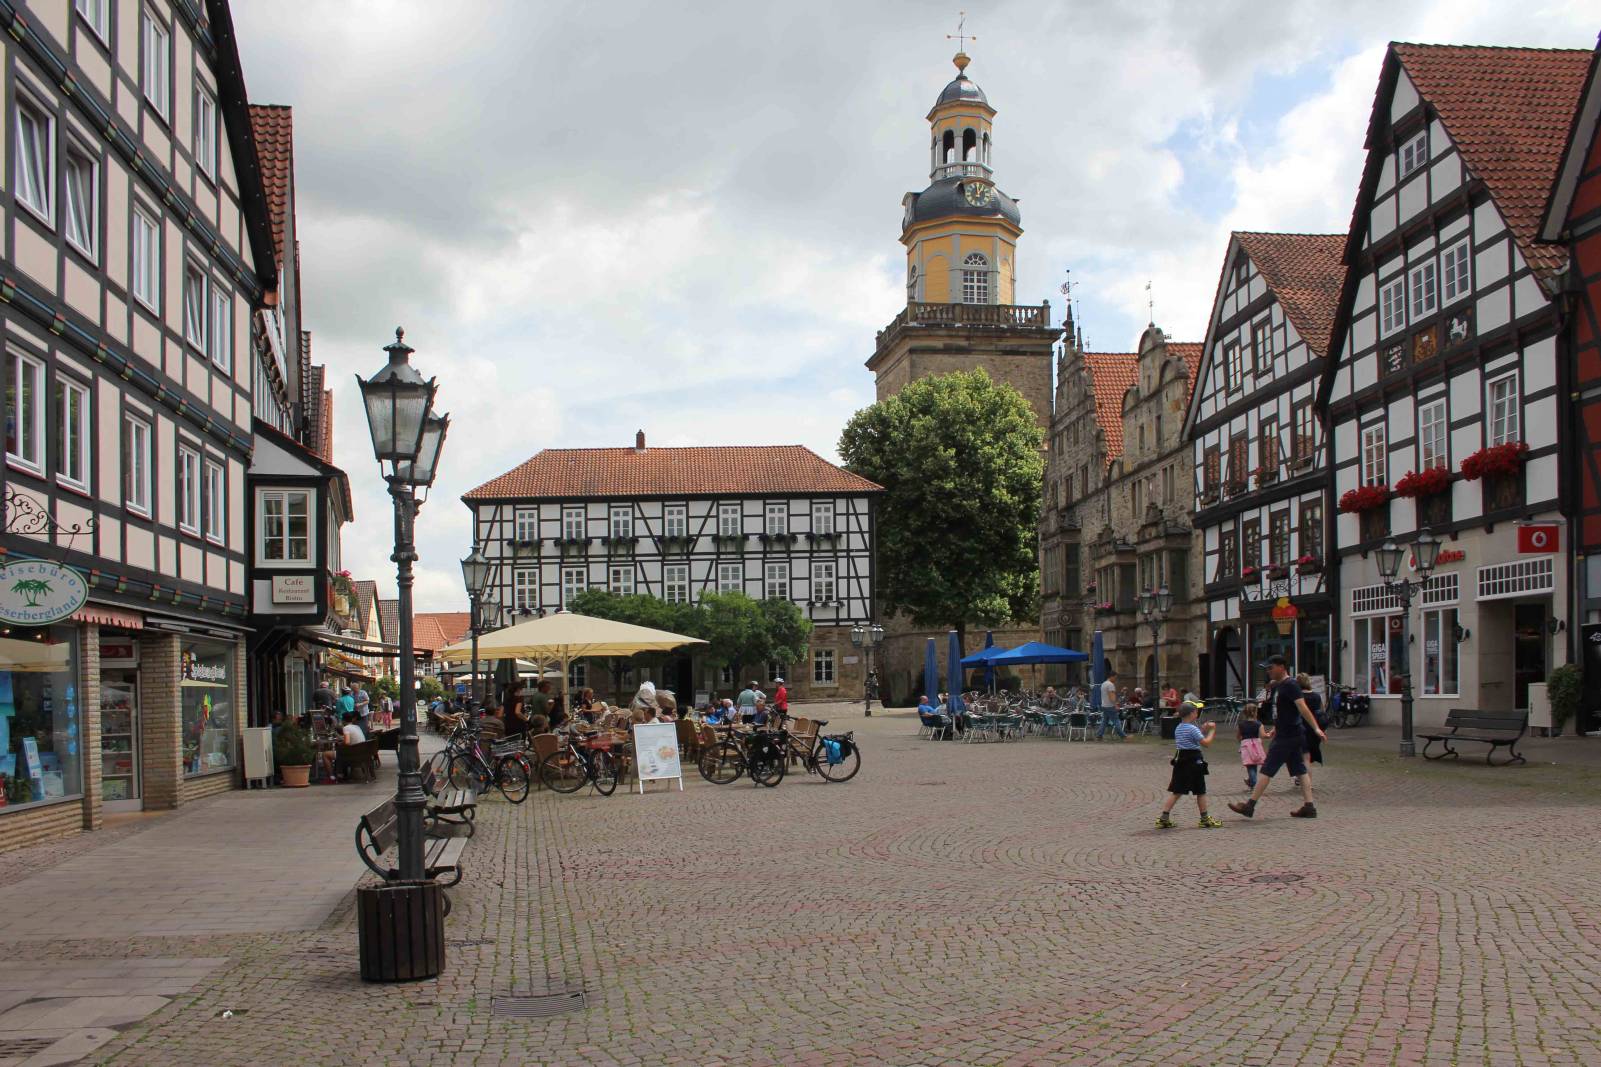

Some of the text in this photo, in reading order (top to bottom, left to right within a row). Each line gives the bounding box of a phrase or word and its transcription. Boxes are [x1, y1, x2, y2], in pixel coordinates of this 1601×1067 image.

[0, 564, 77, 586] eisebüro
[0, 595, 78, 620] eserbergland
[1371, 643, 1386, 653] GIGA
